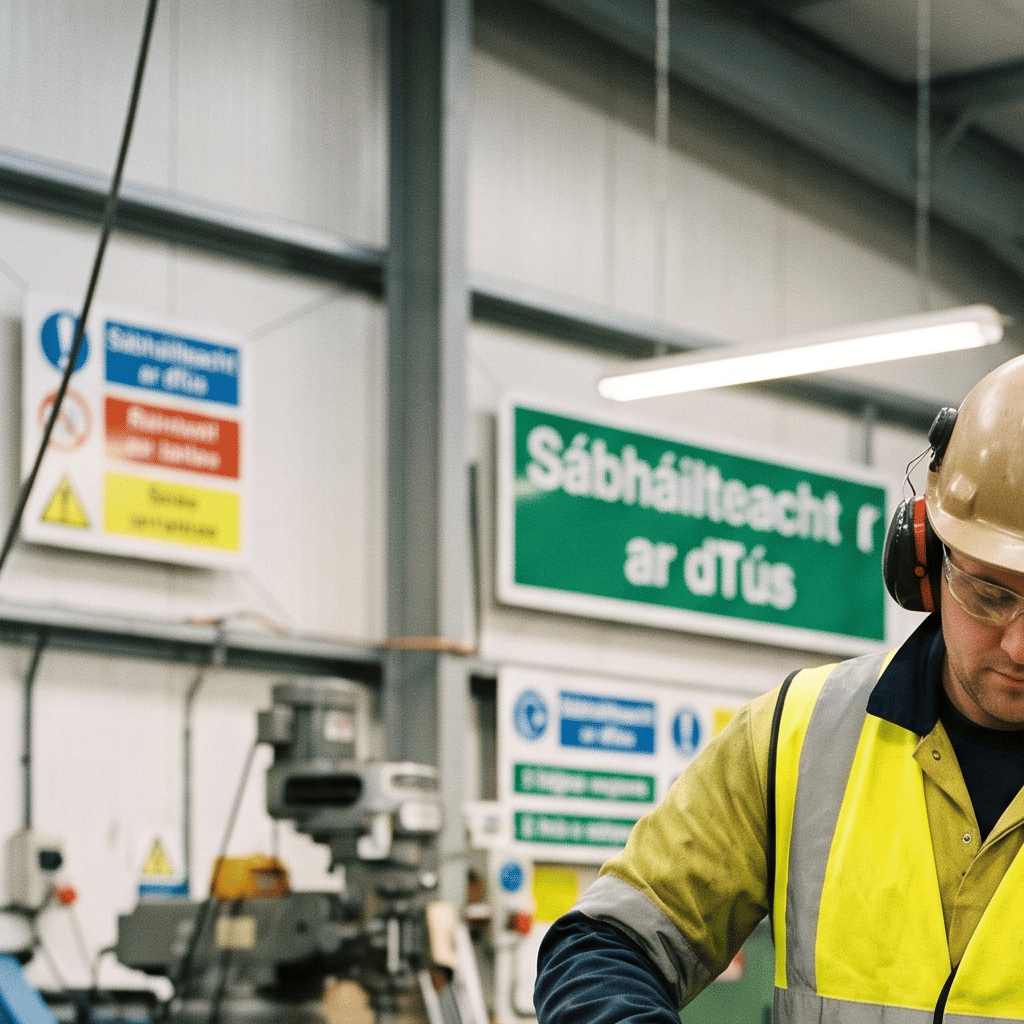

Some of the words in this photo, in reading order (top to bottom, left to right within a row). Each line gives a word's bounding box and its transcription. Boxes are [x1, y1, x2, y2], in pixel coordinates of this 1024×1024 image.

[526, 424, 843, 546] Sábháilteacht
[624, 537, 678, 589] ar
[684, 537, 797, 611] dTús
